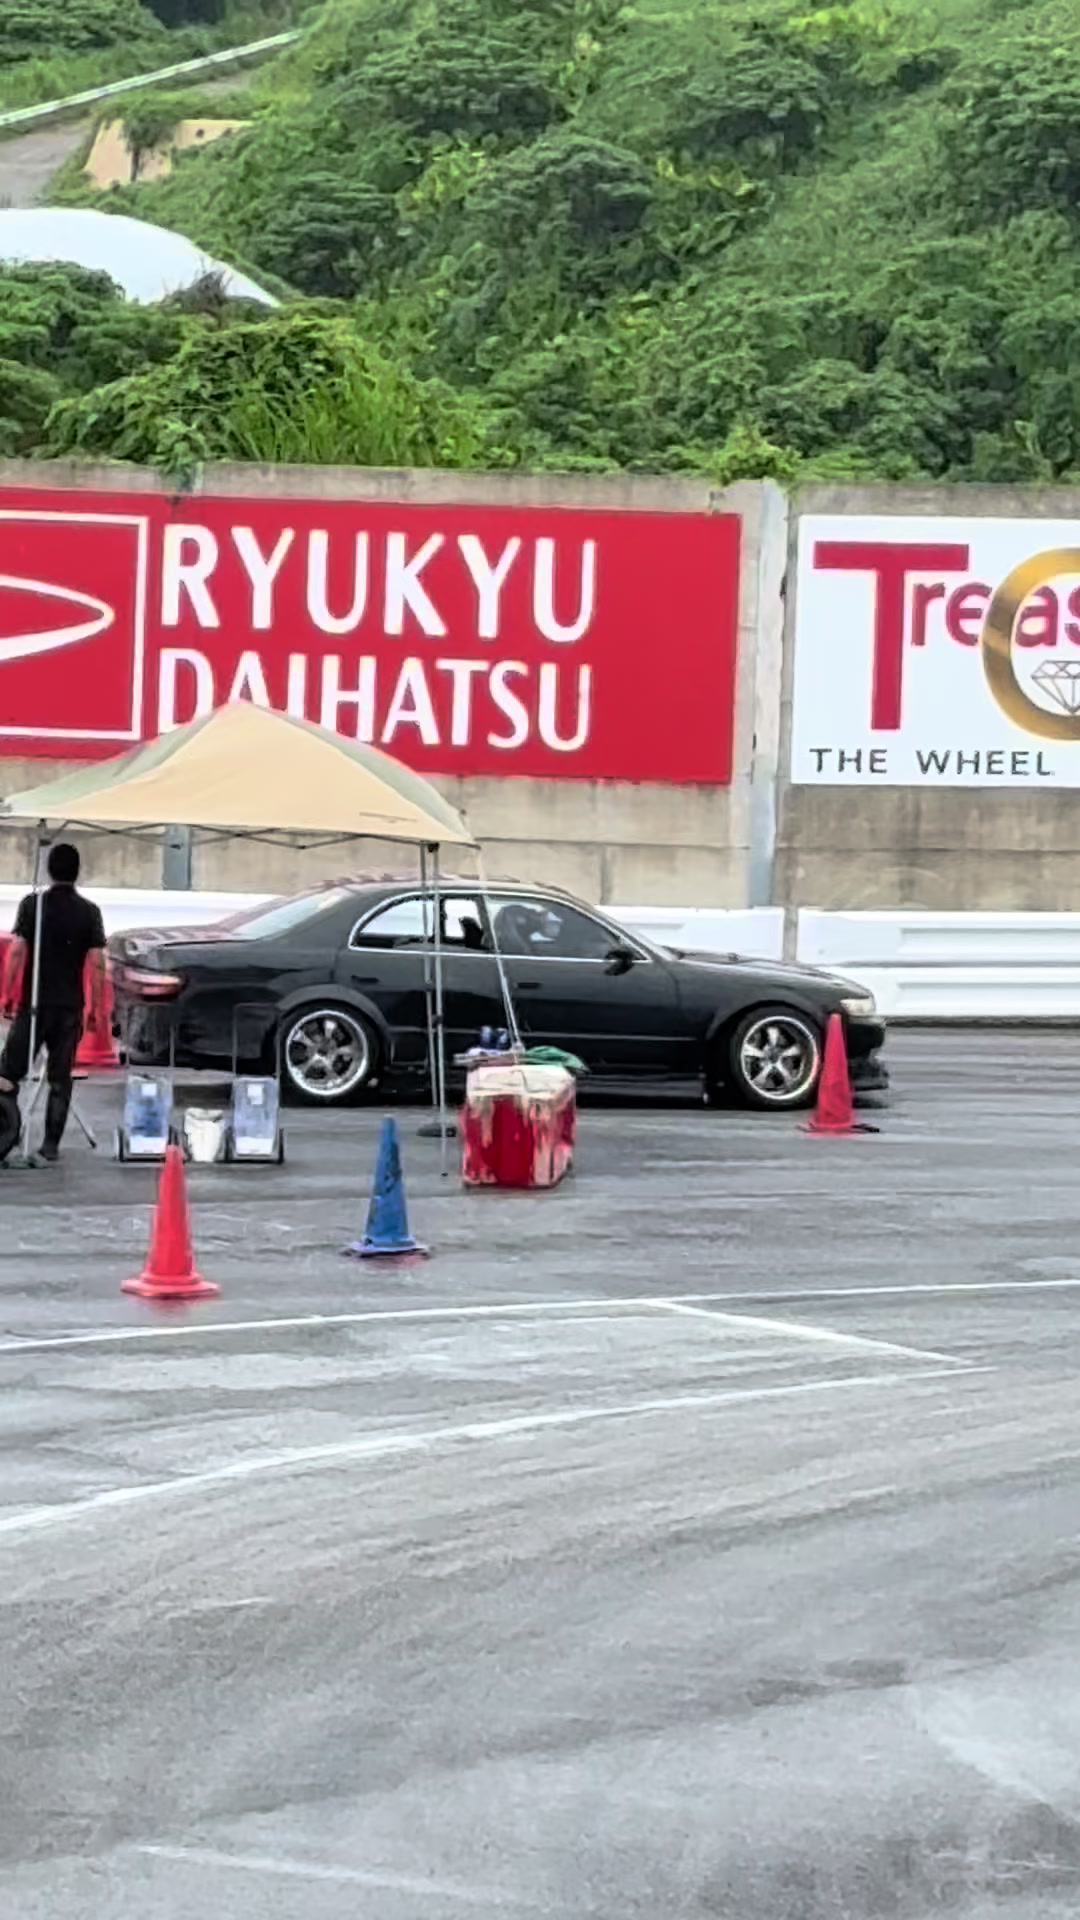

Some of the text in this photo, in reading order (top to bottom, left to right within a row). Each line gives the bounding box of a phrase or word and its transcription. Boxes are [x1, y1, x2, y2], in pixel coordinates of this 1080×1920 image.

[161, 523, 597, 642] RYUKYU
[158, 648, 591, 751] DAIHATSU
[809, 748, 1053, 776] THE WHEEL
